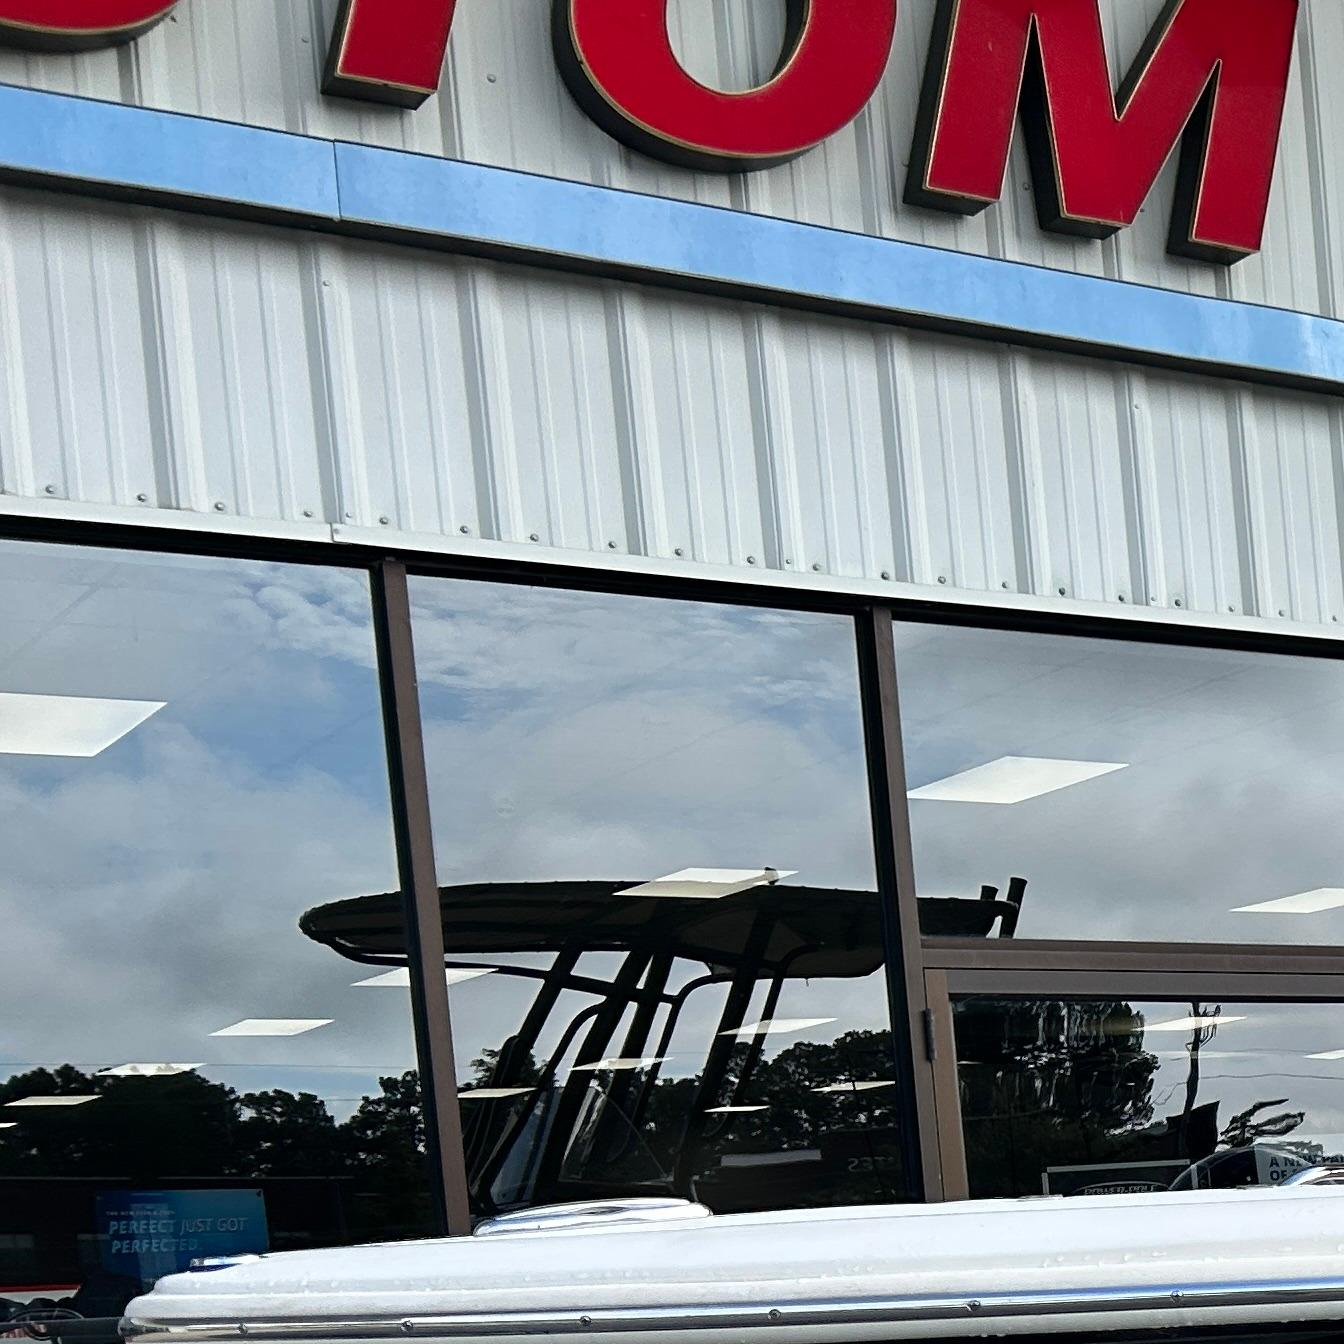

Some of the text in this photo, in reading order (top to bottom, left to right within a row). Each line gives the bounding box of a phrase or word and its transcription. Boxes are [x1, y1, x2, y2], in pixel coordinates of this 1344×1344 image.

[109, 1216, 249, 1236] PERFECT JUST GOT
